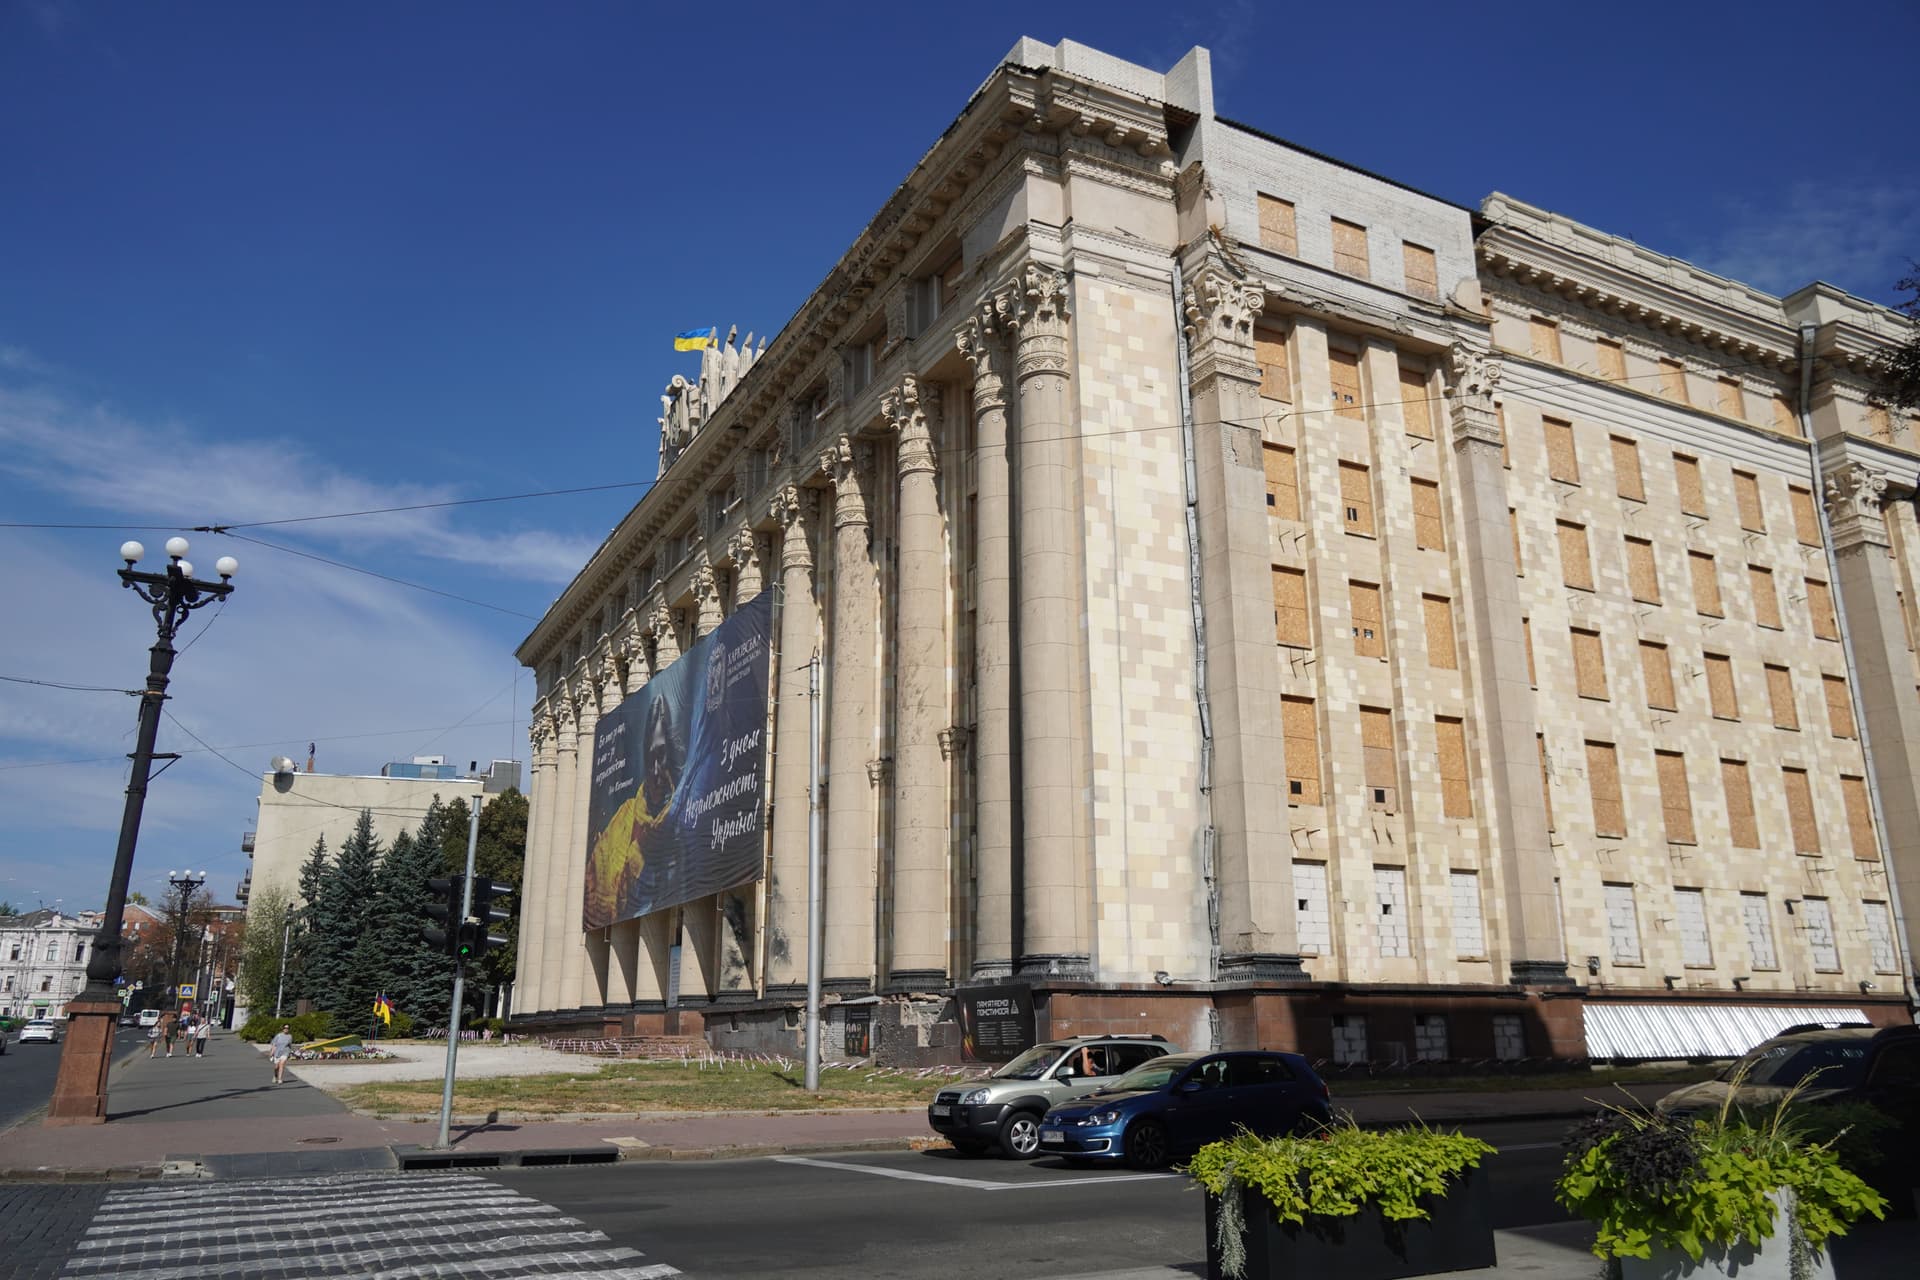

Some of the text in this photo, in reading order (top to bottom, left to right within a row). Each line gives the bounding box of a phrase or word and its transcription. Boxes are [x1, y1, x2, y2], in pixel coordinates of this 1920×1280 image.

[728, 729, 760, 773] днем
[684, 762, 758, 829] Незалежності,
[711, 798, 760, 853] Україно!
